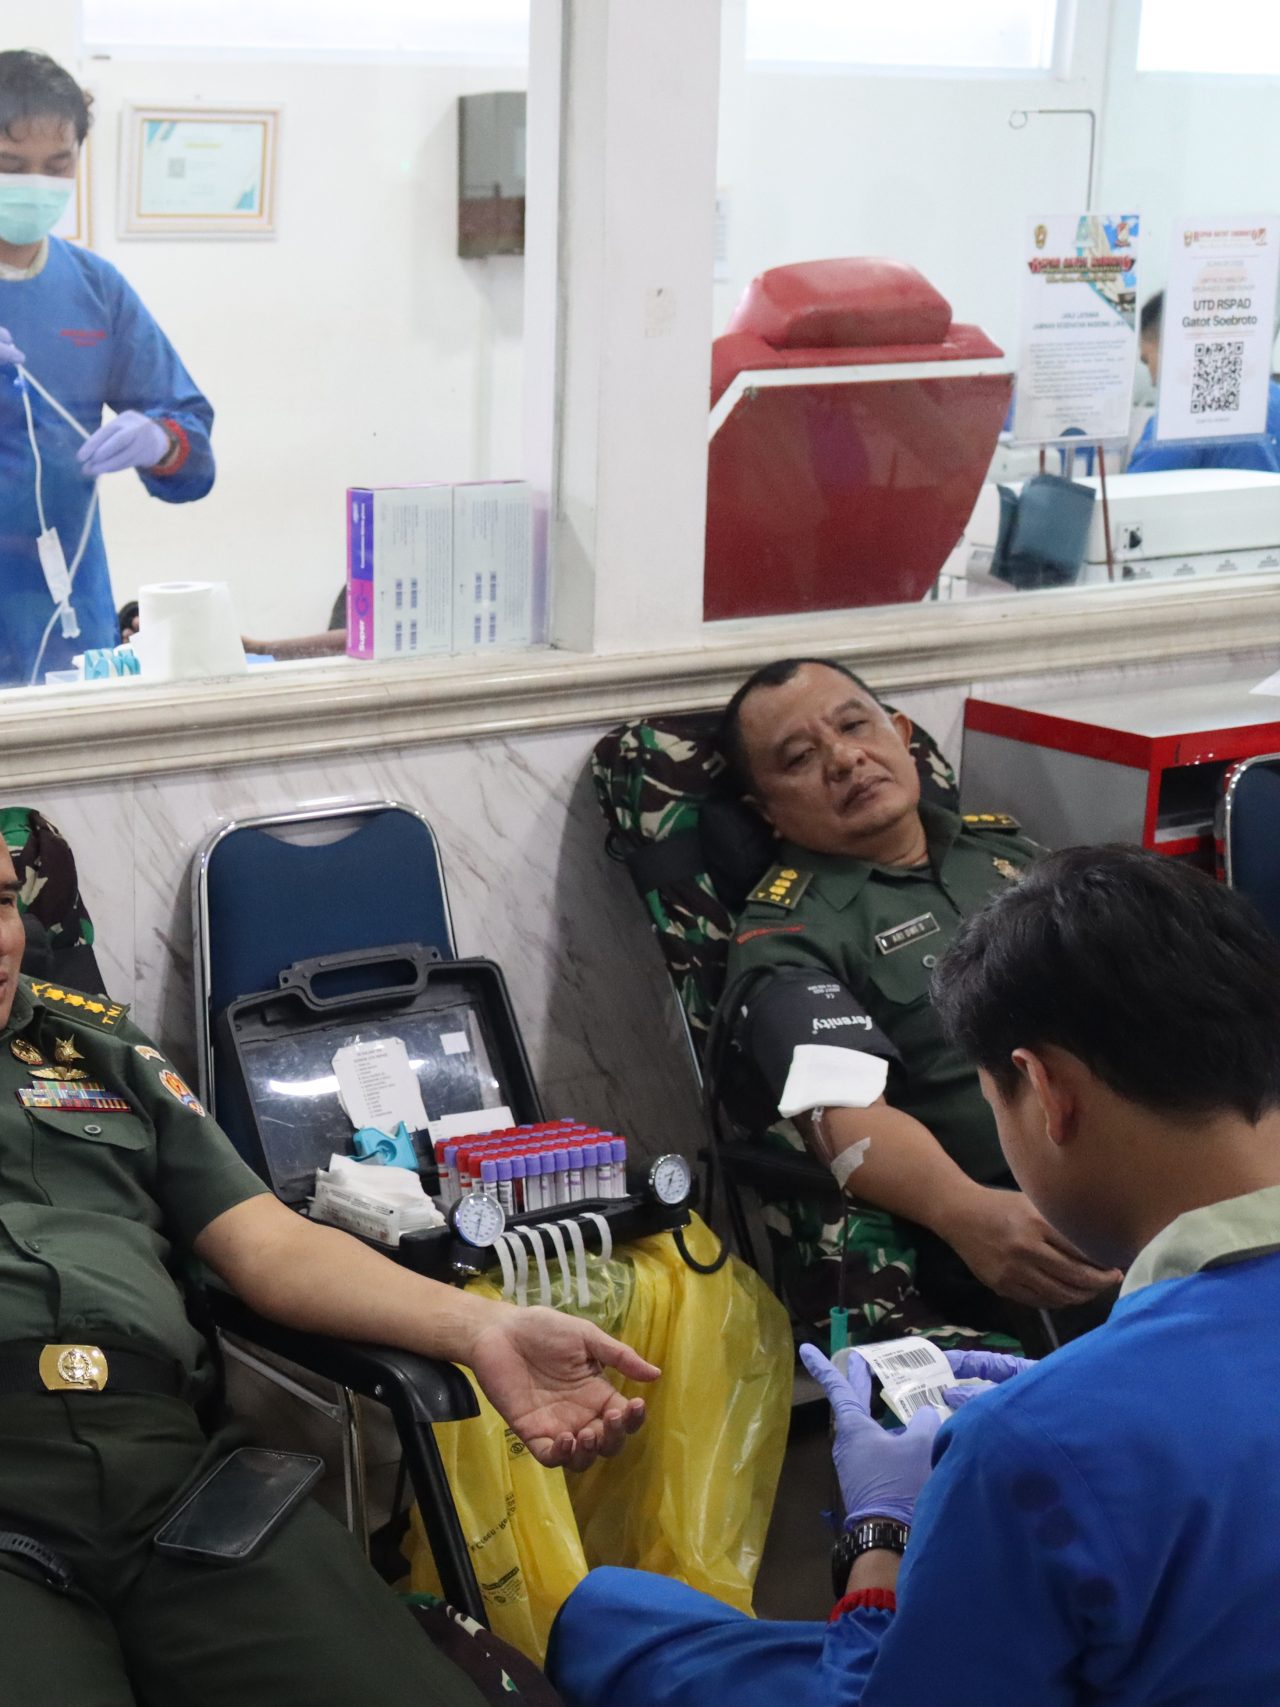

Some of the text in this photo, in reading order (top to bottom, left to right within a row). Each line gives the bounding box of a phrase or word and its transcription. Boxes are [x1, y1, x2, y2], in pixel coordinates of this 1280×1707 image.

[1193, 299, 1251, 311] UTD RSPAD
[1182, 315, 1257, 328] Gatot Soebroto
[102, 1004, 123, 1025] TNI
